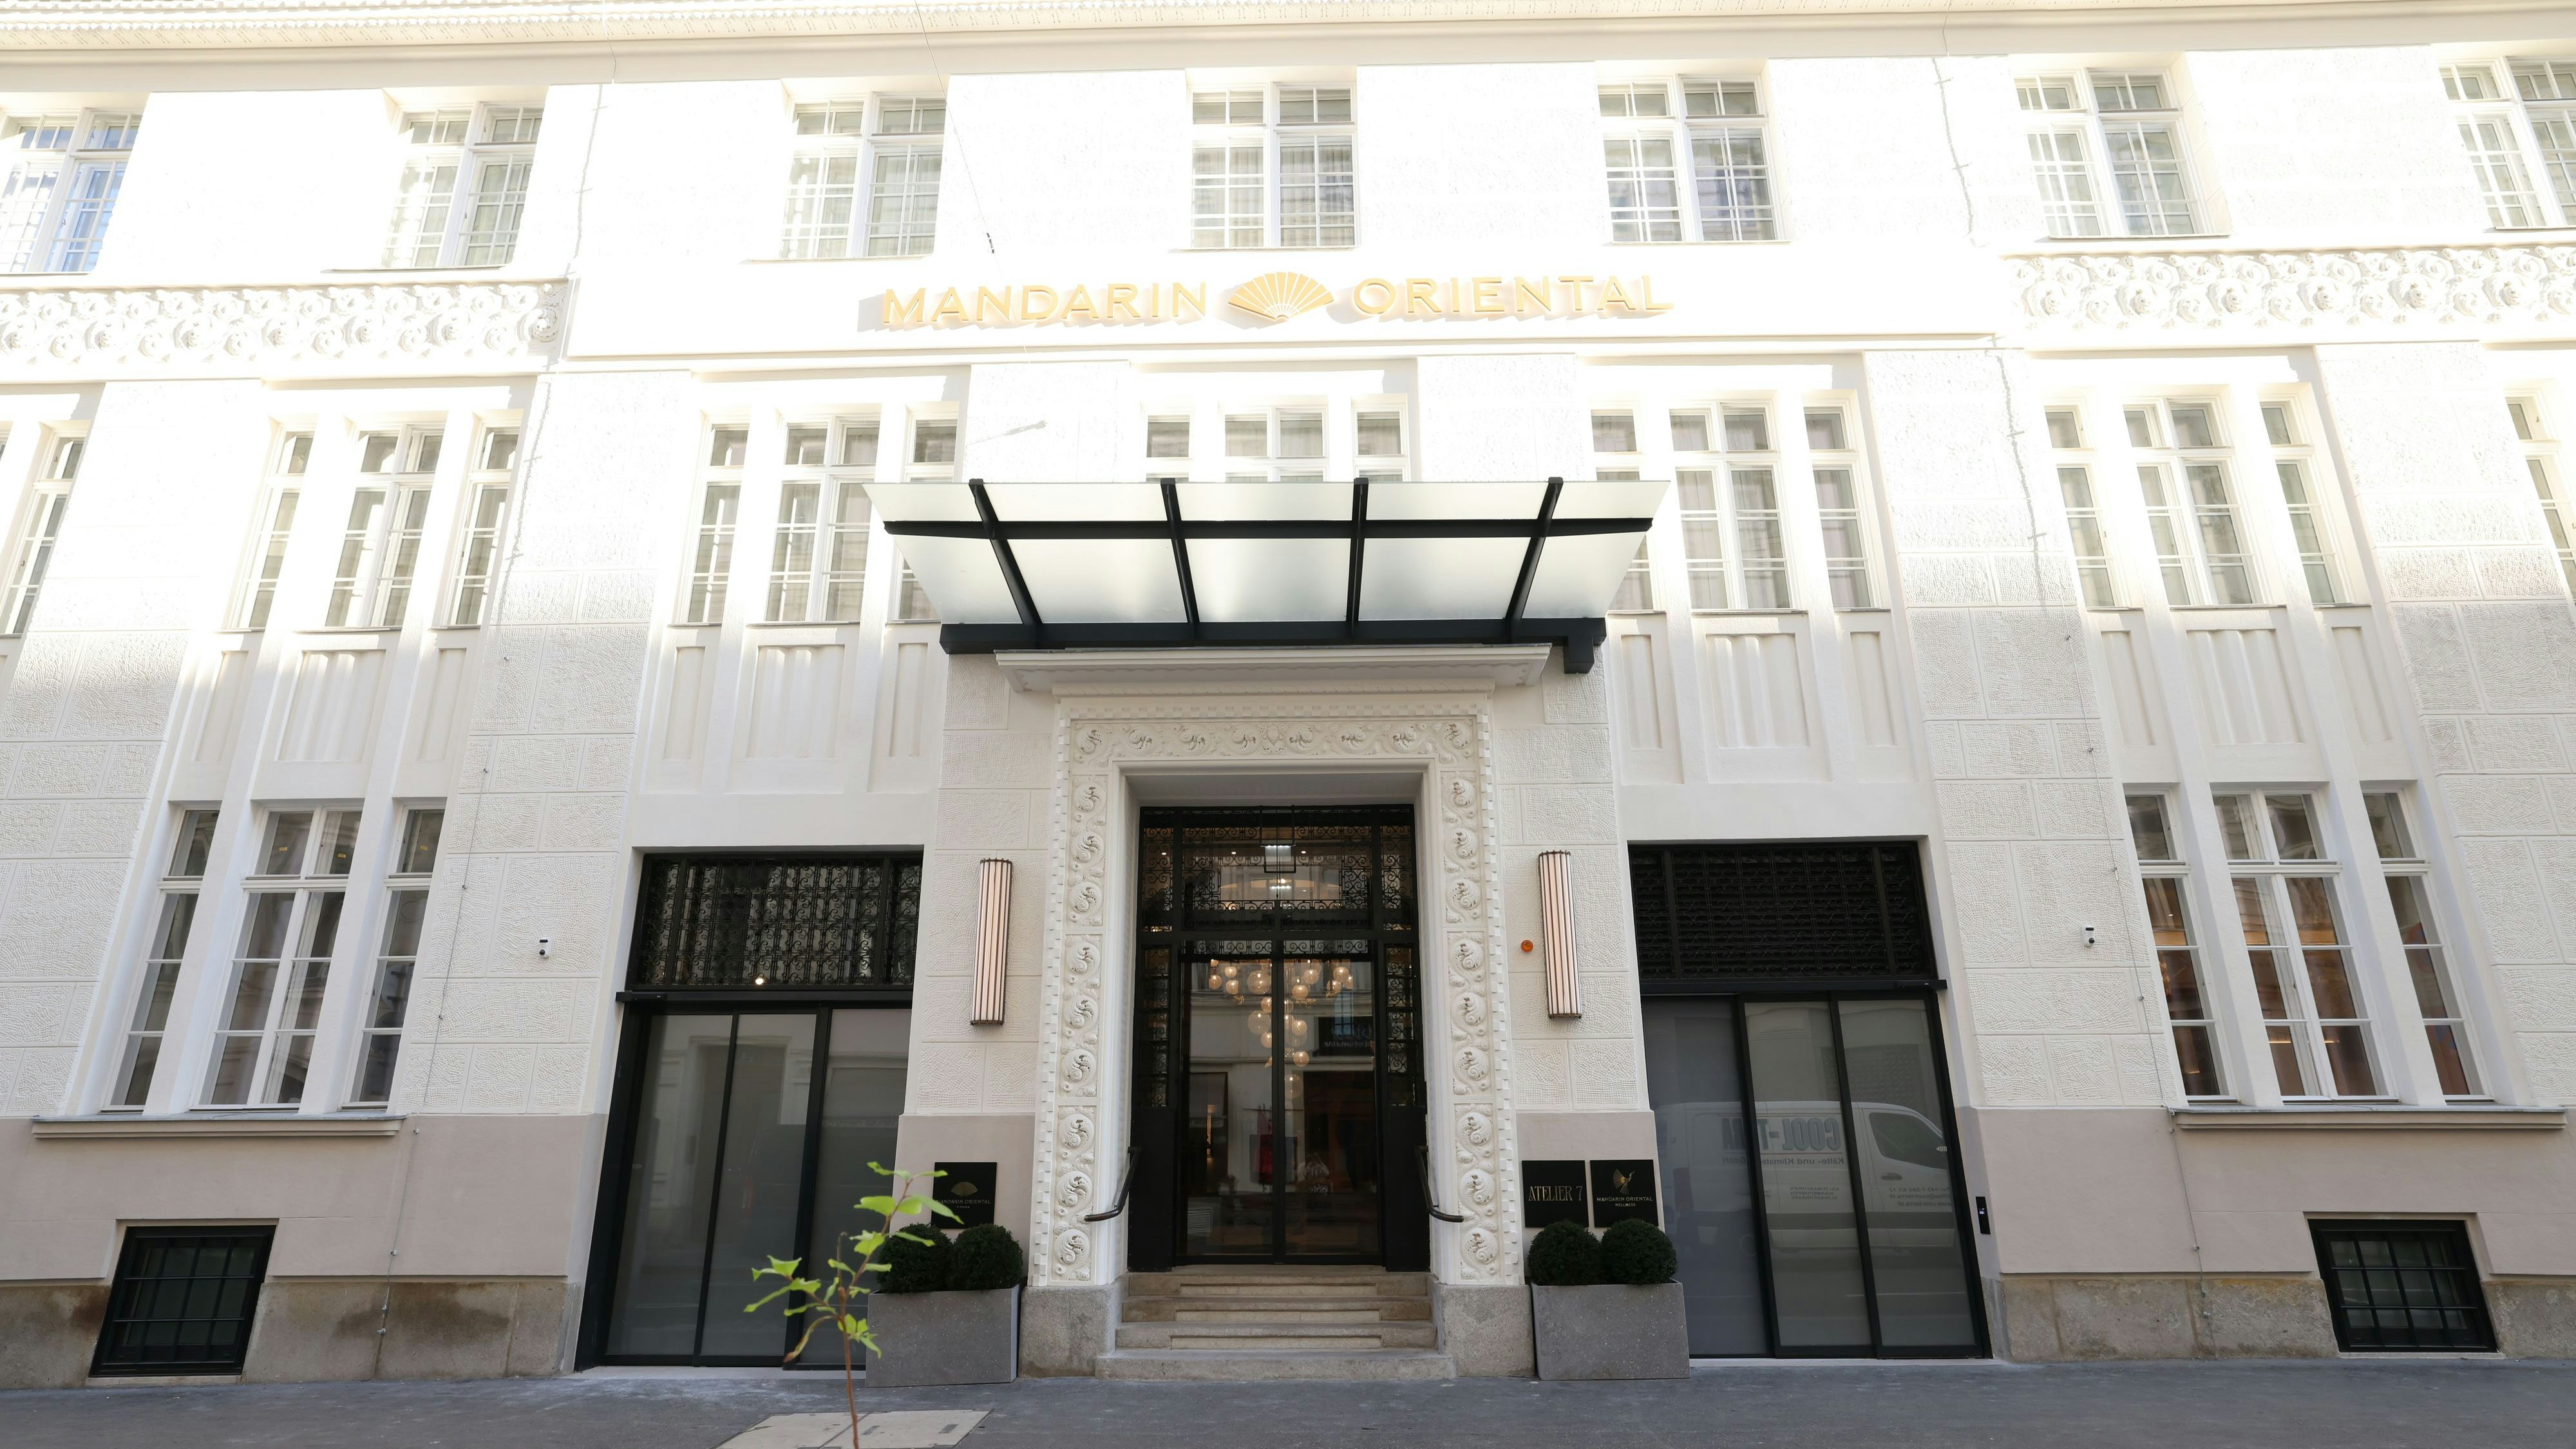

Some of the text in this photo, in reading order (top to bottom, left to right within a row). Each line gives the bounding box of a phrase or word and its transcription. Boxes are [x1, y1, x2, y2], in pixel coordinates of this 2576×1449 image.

[884, 275, 1674, 323] MANDARIN ORIENTAL
[1528, 1186, 1583, 1201] ATELIER 7
